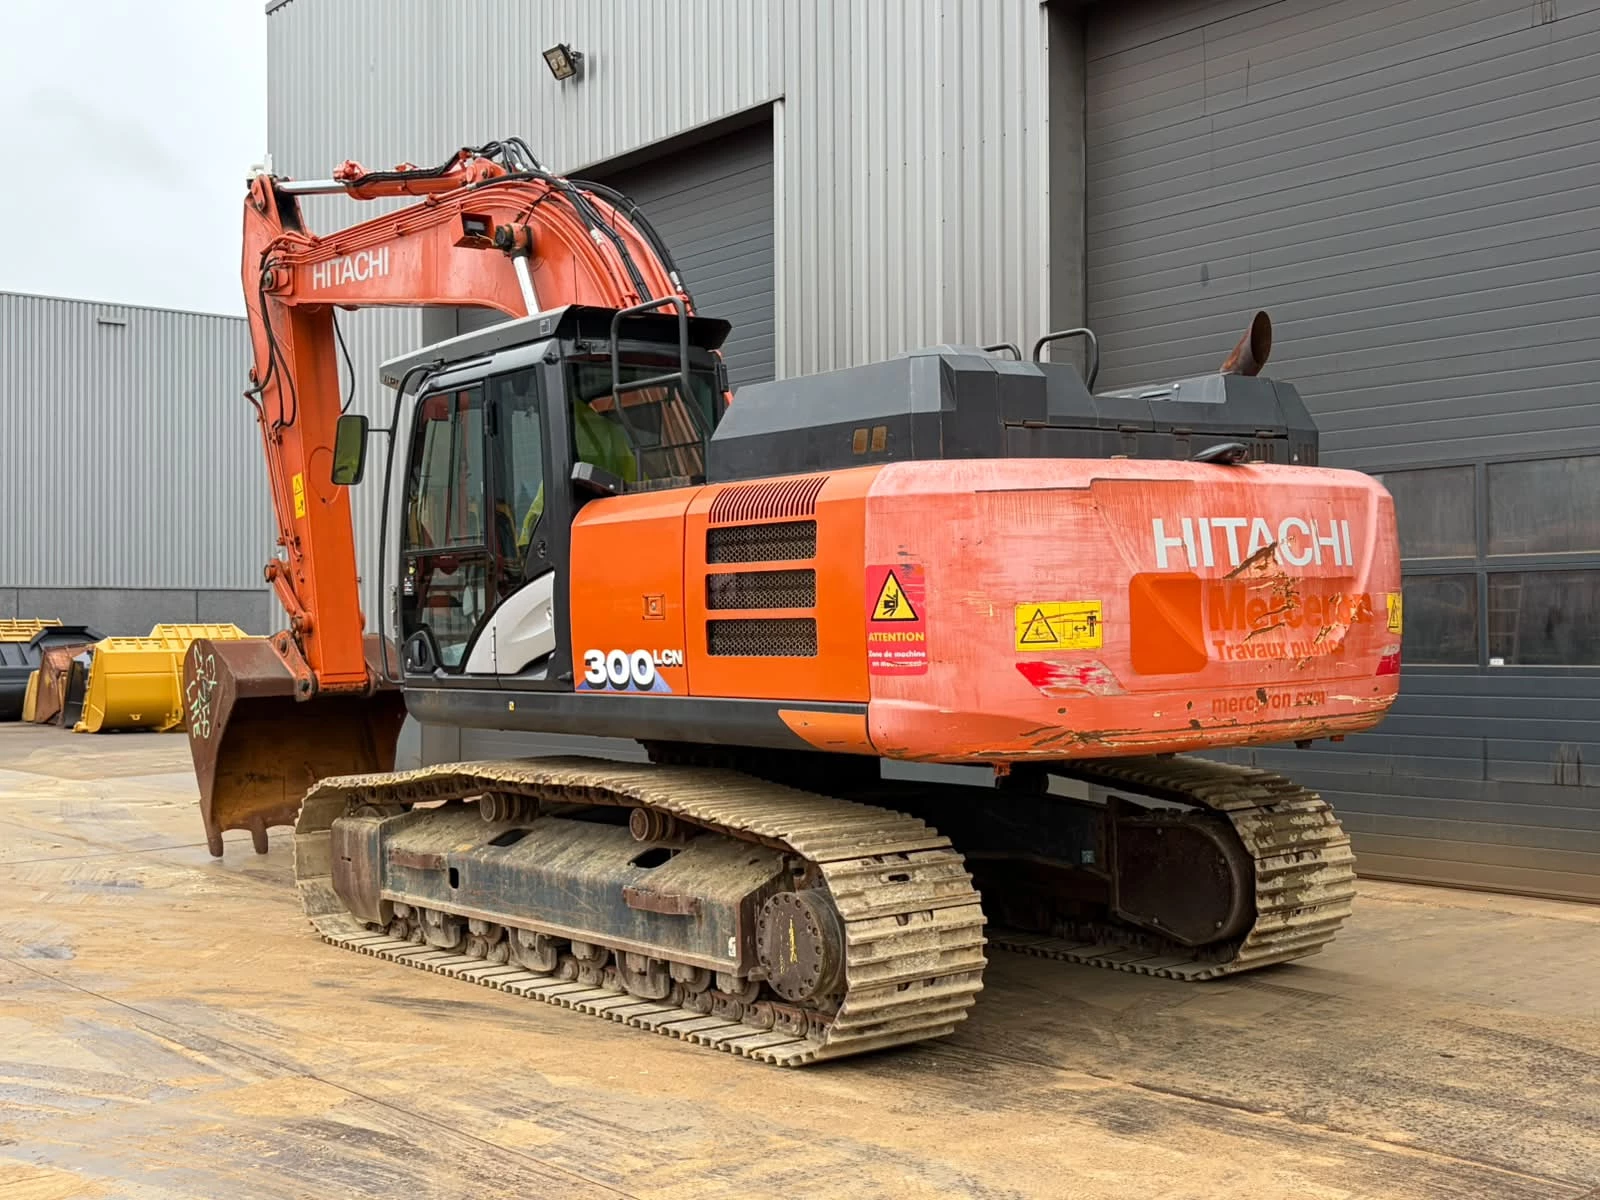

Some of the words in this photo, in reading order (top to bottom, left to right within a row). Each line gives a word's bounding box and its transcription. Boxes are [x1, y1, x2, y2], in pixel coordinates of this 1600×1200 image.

[312, 246, 389, 291] HITACHI
[1152, 517, 1353, 568] HITACHI
[868, 632, 925, 642] ATTENTION
[1212, 639, 1287, 660] Travaux
